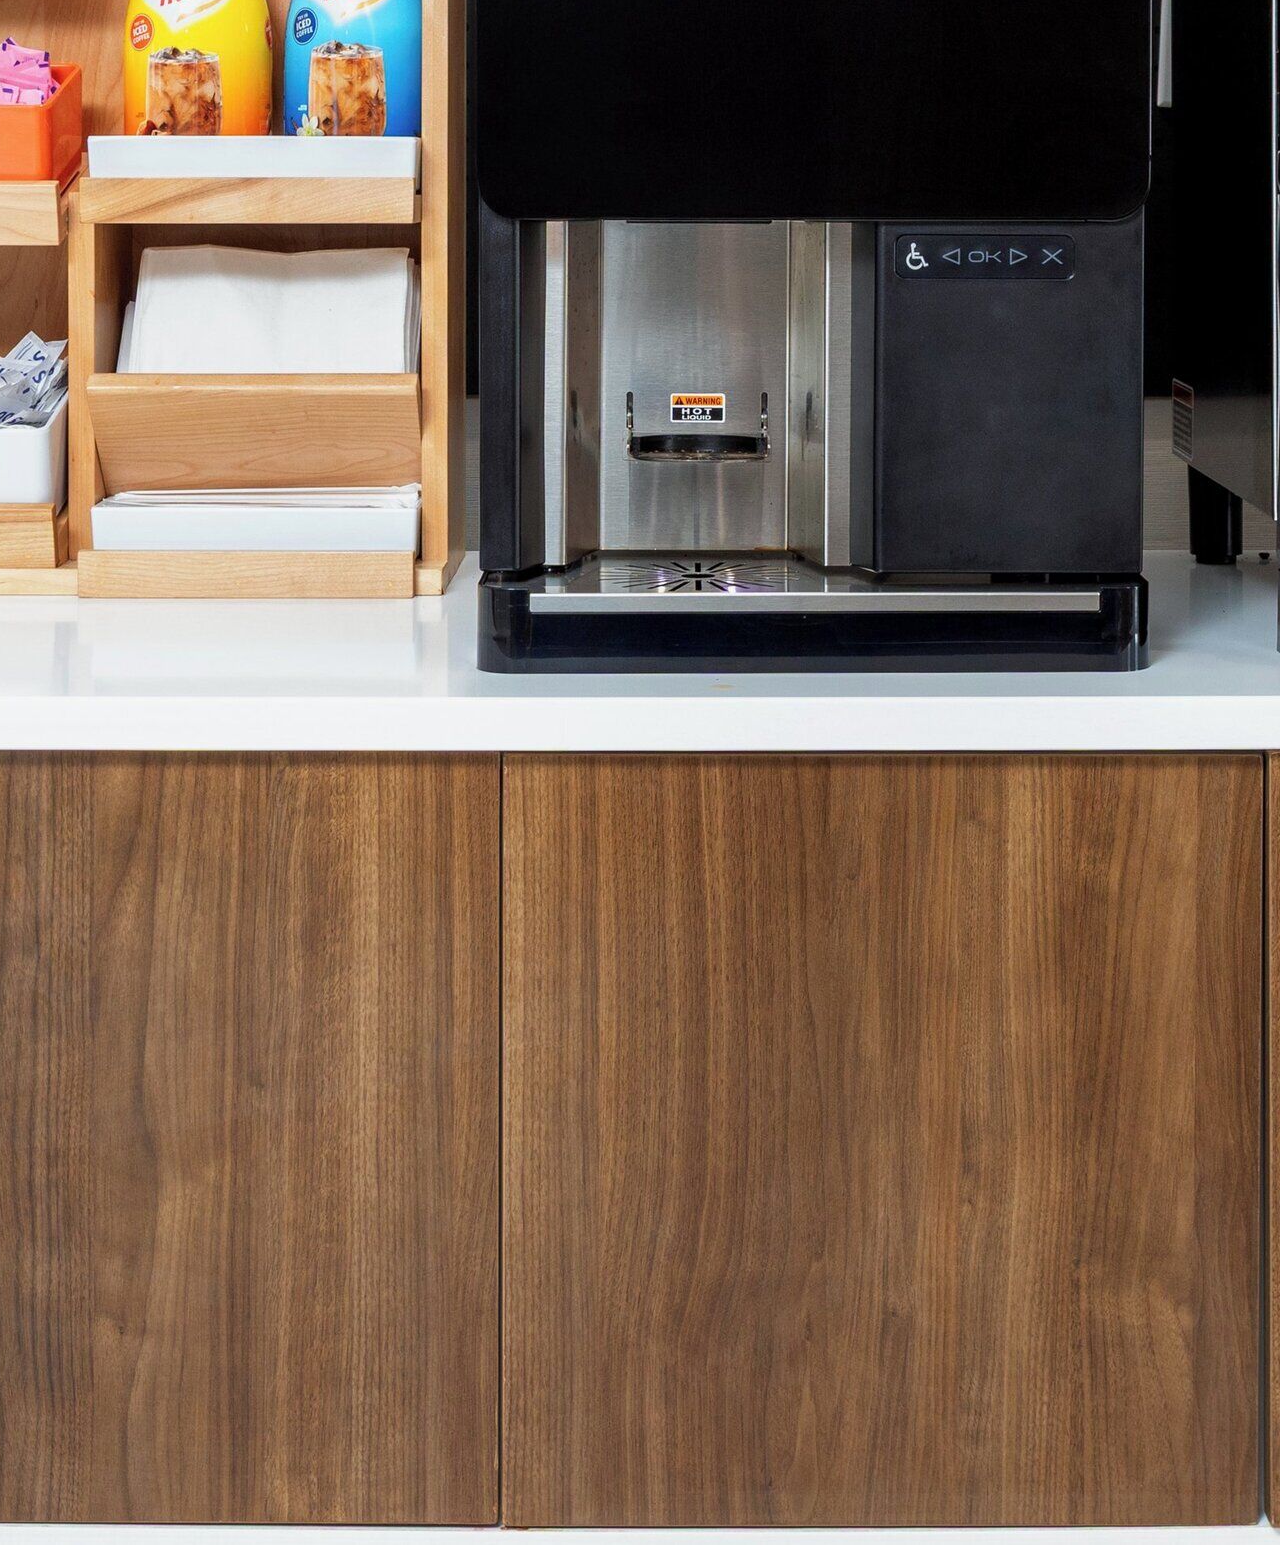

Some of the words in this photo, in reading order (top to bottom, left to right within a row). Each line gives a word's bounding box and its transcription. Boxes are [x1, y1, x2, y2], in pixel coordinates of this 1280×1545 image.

[296, 18, 312, 31] ICED
[296, 25, 314, 39] COFFEE
[968, 250, 1002, 263] OK
[686, 397, 721, 405] WARNING
